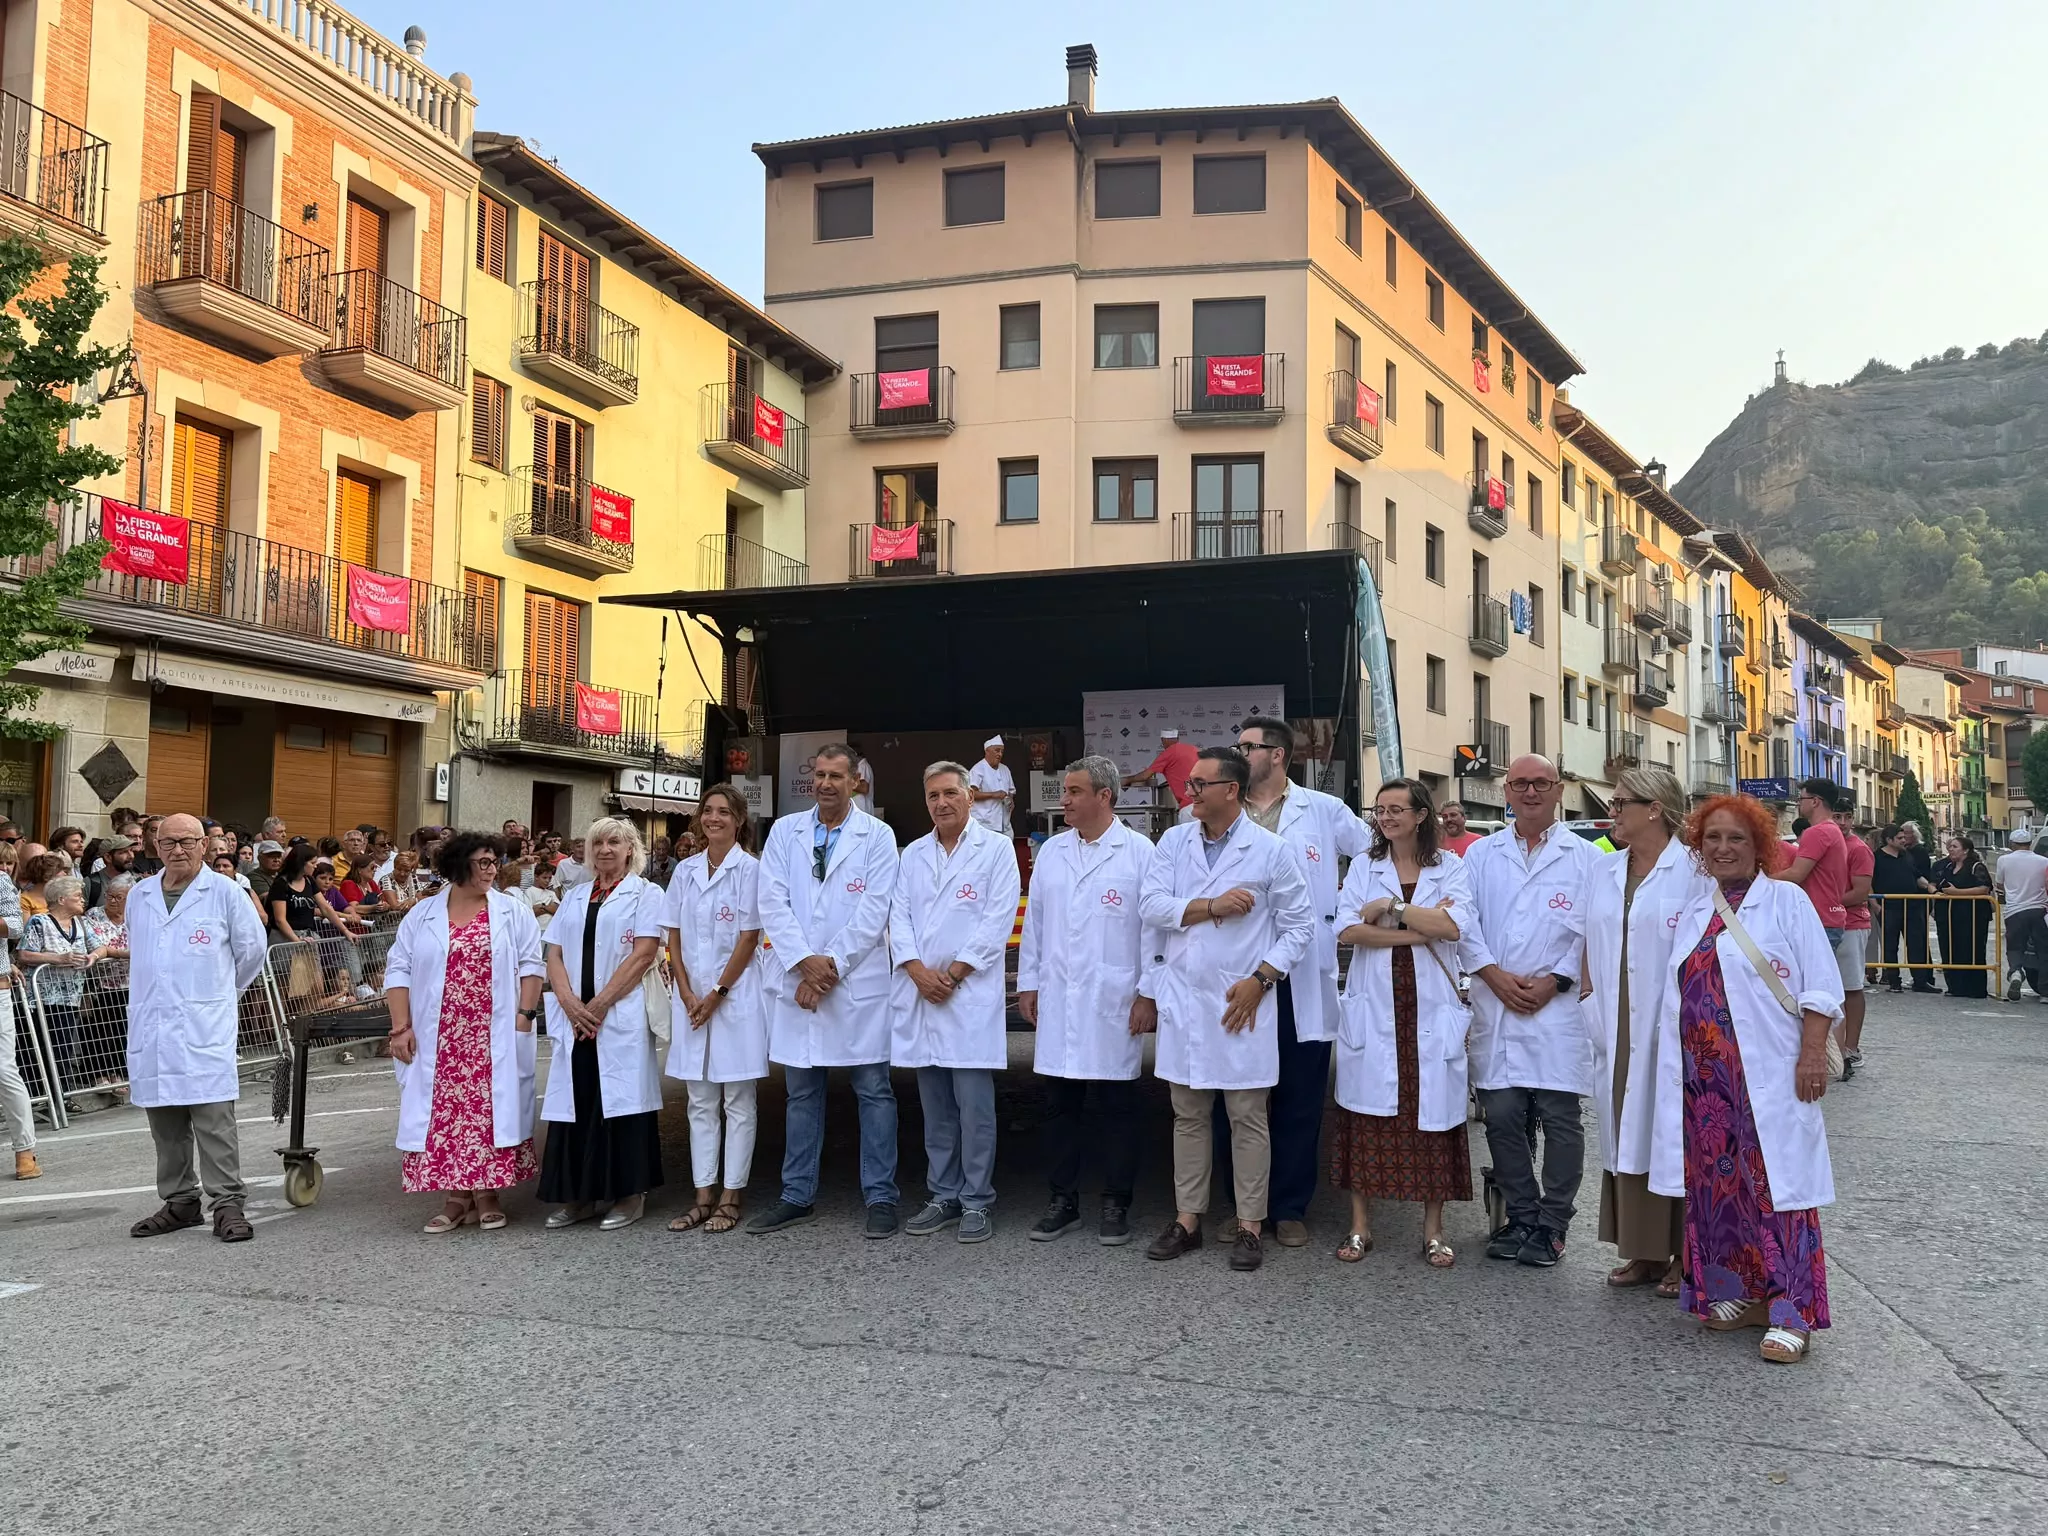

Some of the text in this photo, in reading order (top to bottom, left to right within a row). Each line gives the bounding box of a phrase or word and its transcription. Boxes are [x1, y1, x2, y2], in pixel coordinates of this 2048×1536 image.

[115, 511, 162, 532] LA FIESTA
[55, 655, 96, 673] Melsa
[154, 668, 205, 682] RADICIÓN
[211, 676, 216, 684] Y
[282, 688, 311, 698] DESDE
[398, 703, 423, 718] Melsa
[743, 791, 761, 799] SABOR
